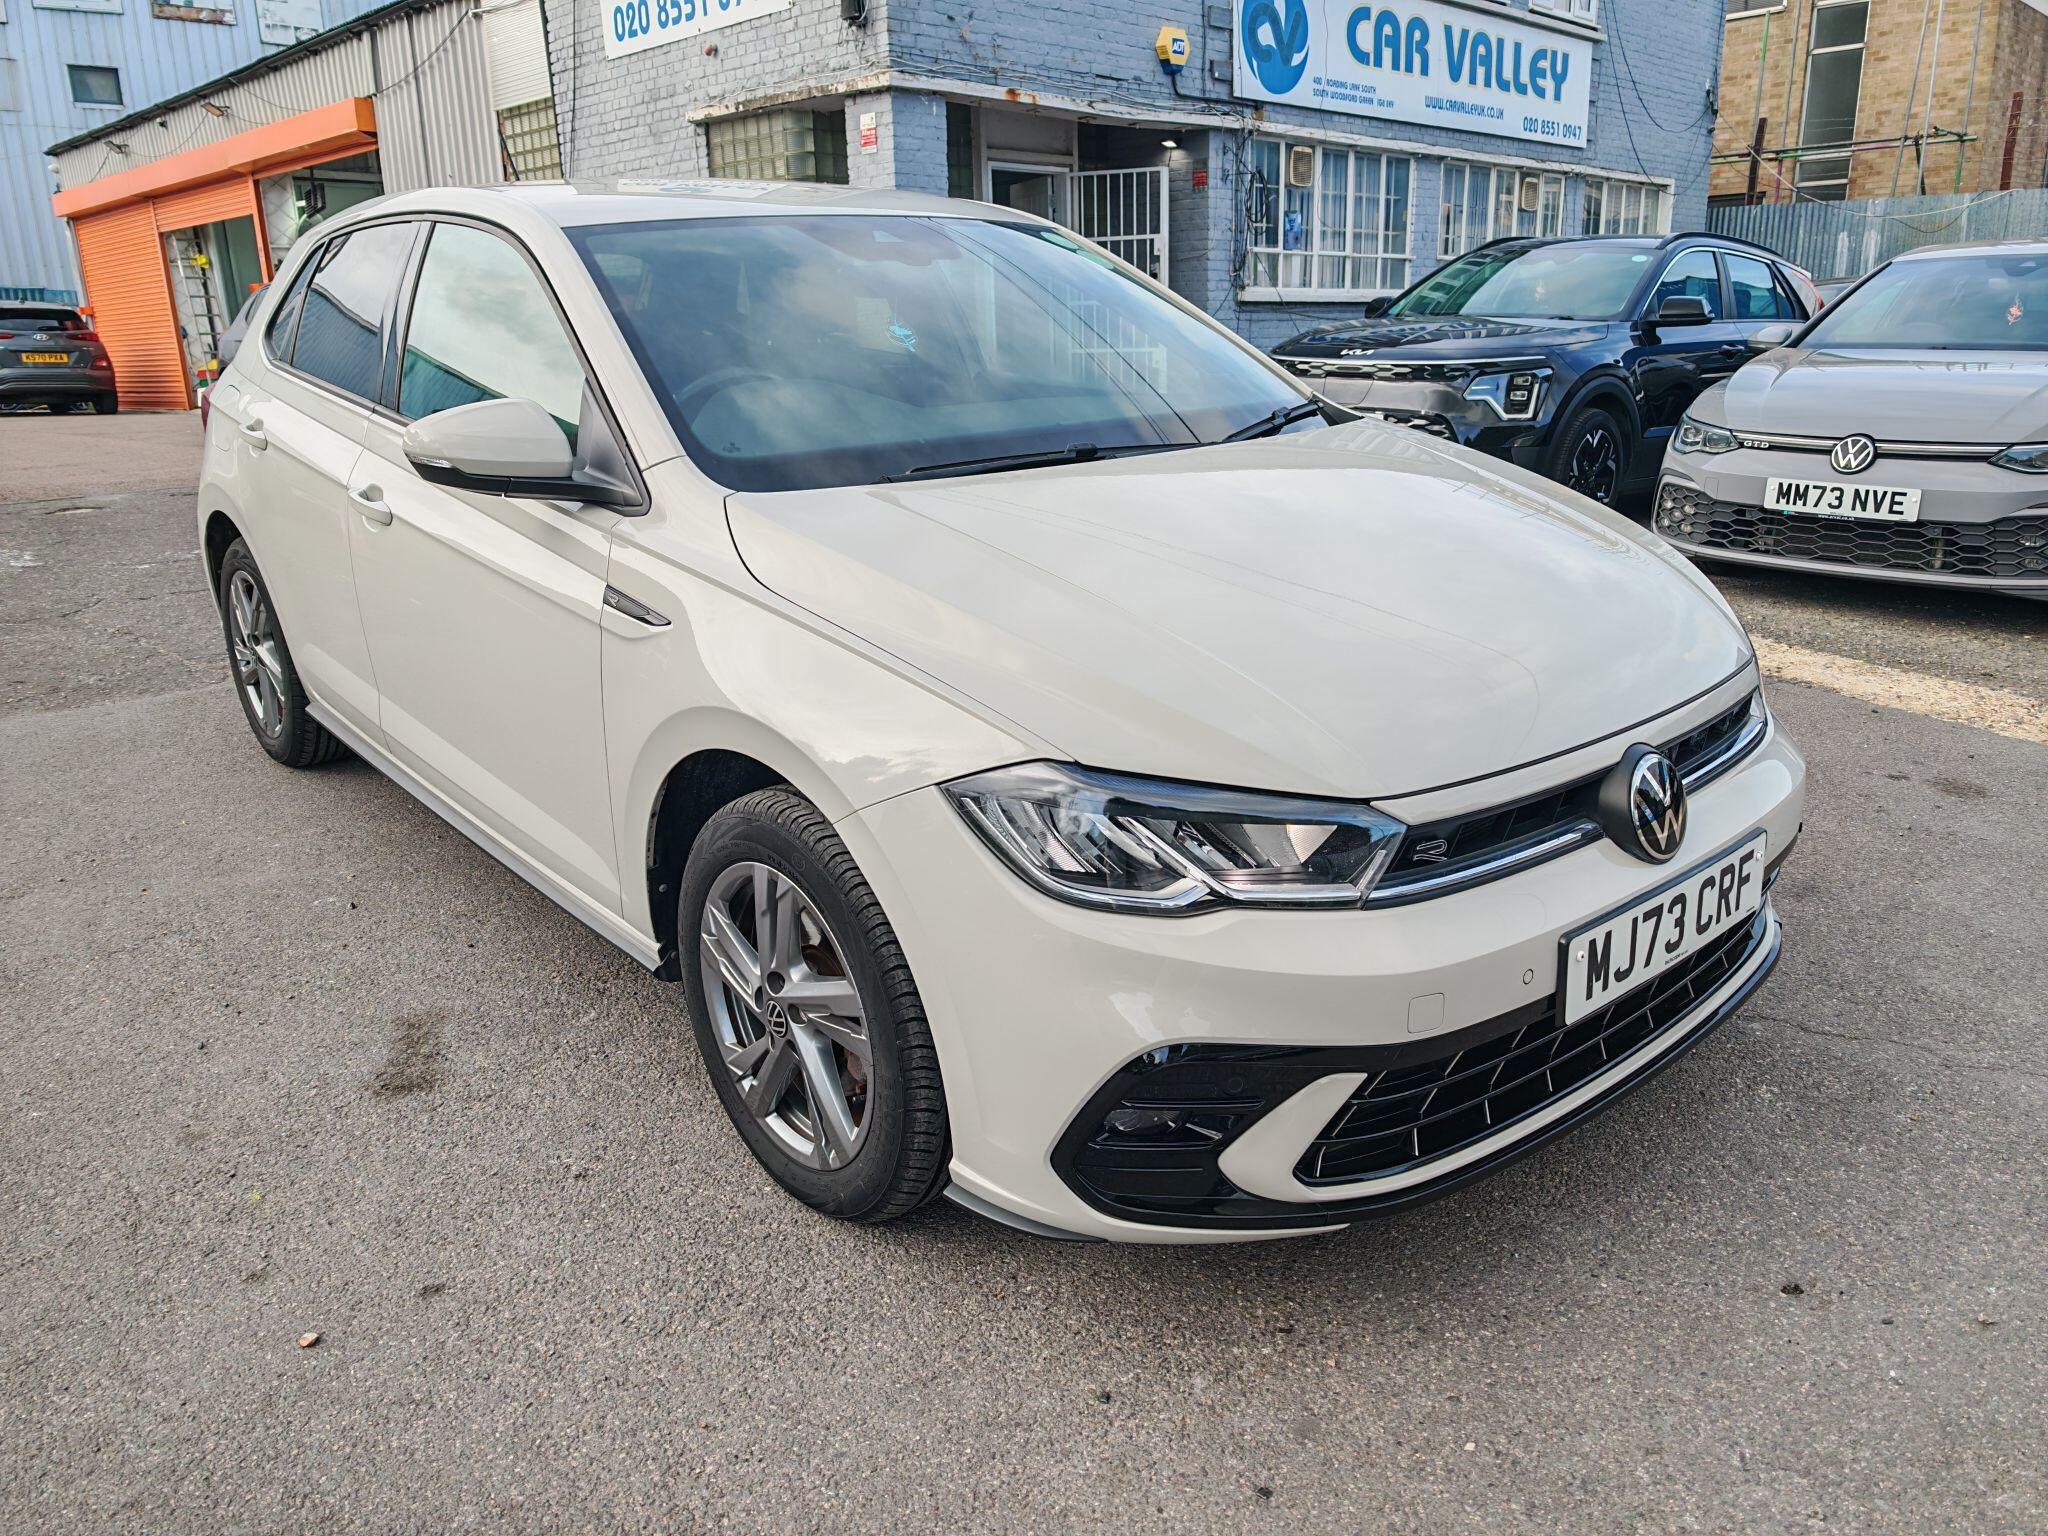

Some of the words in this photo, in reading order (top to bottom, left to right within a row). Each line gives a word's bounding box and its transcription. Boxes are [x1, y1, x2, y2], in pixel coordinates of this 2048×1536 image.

[613, 0, 650, 42] 020
[1172, 40, 1185, 53] ADT
[1346, 6, 1430, 77] CAR
[1443, 23, 1570, 102] VALLEY
[1312, 88, 1329, 98] SOUTH
[1329, 90, 1358, 103] WOODFORD
[1361, 84, 1377, 95] SOUTH
[1424, 95, 1504, 121] WWW.CARVALLEYUK.CO.UK
[1523, 116, 1539, 133] 020
[1540, 120, 1561, 137] 8551
[1562, 125, 1582, 141] 0947
[1743, 440, 1770, 449] GTD
[1775, 481, 1845, 510] MM73
[1850, 487, 1908, 516] NVE
[1585, 892, 1688, 1002] MJ73
[1695, 848, 1756, 937] CRF
